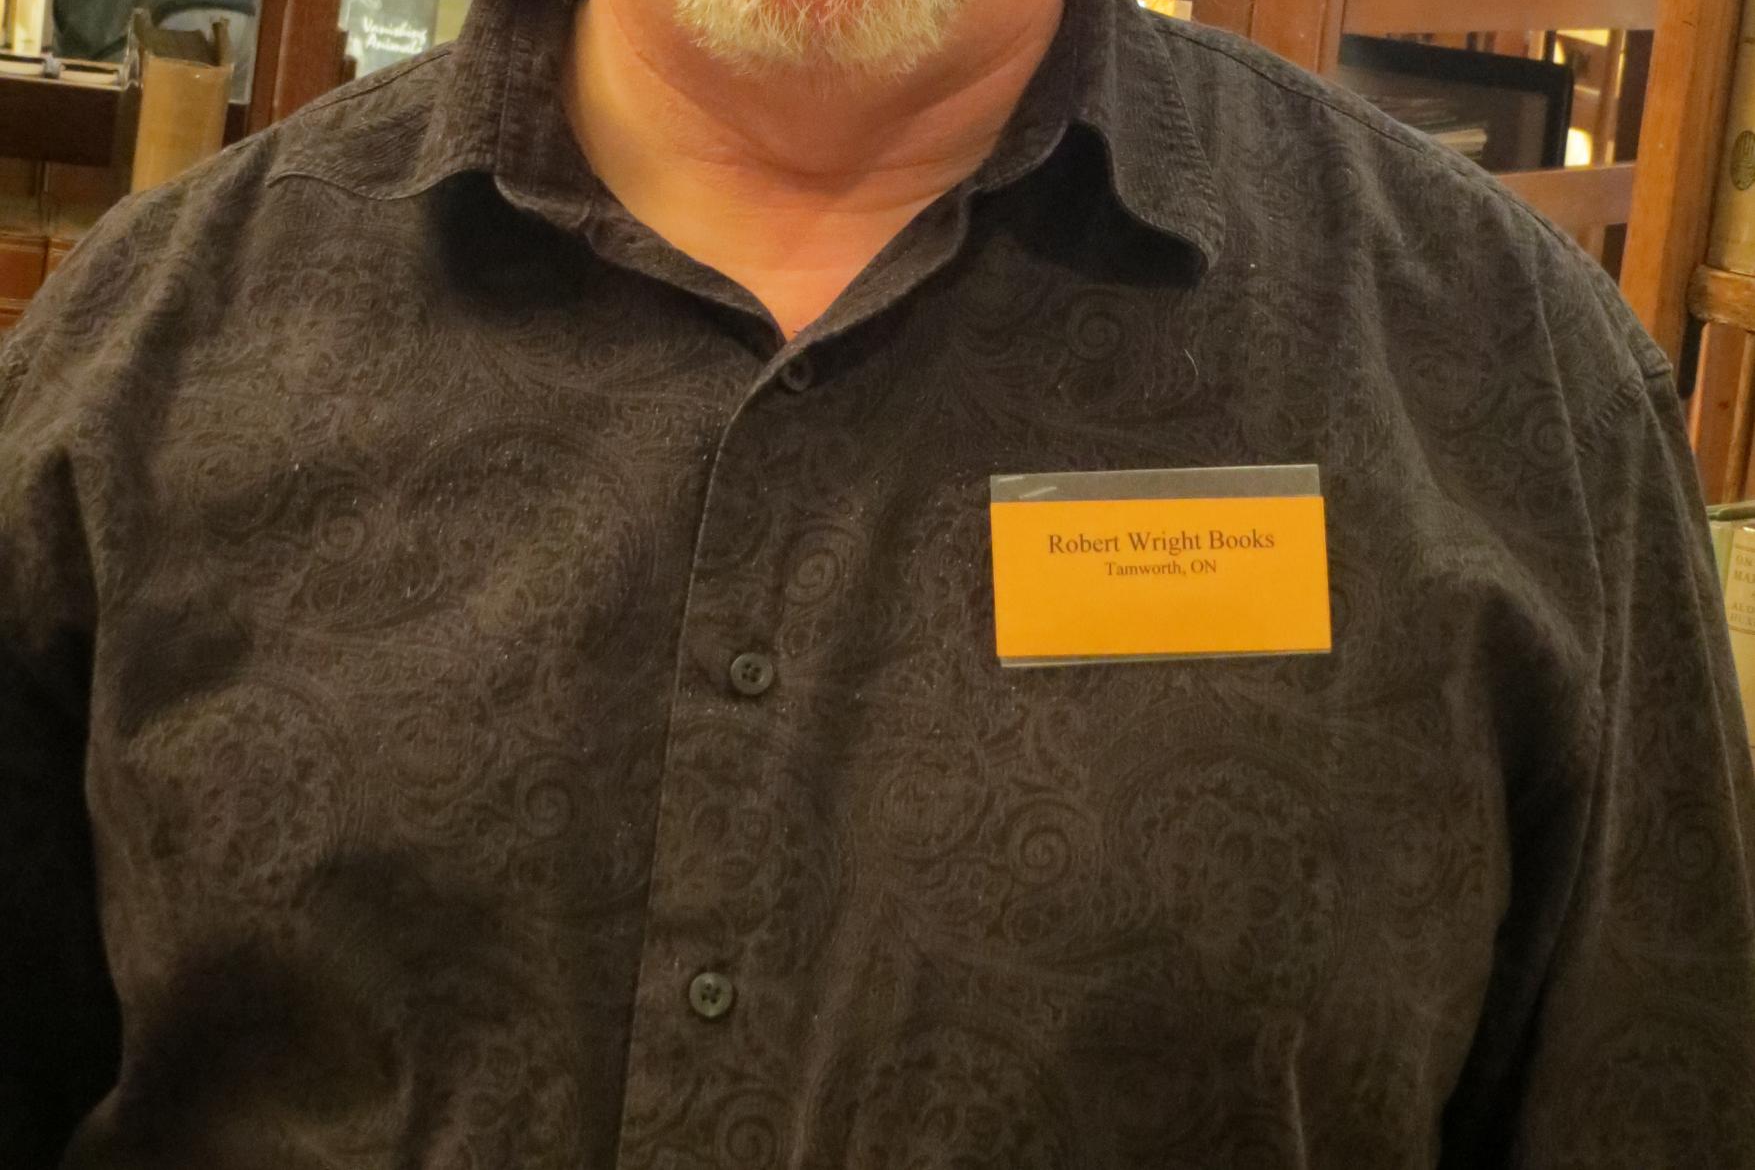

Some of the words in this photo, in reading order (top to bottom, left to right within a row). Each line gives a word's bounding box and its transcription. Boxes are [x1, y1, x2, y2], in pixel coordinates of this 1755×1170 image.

[1049, 533, 1120, 554] Robert
[1128, 530, 1203, 556] Wright
[1209, 529, 1275, 550] Books
[1104, 560, 1187, 577] Tamworth,
[1191, 559, 1217, 574] ON
